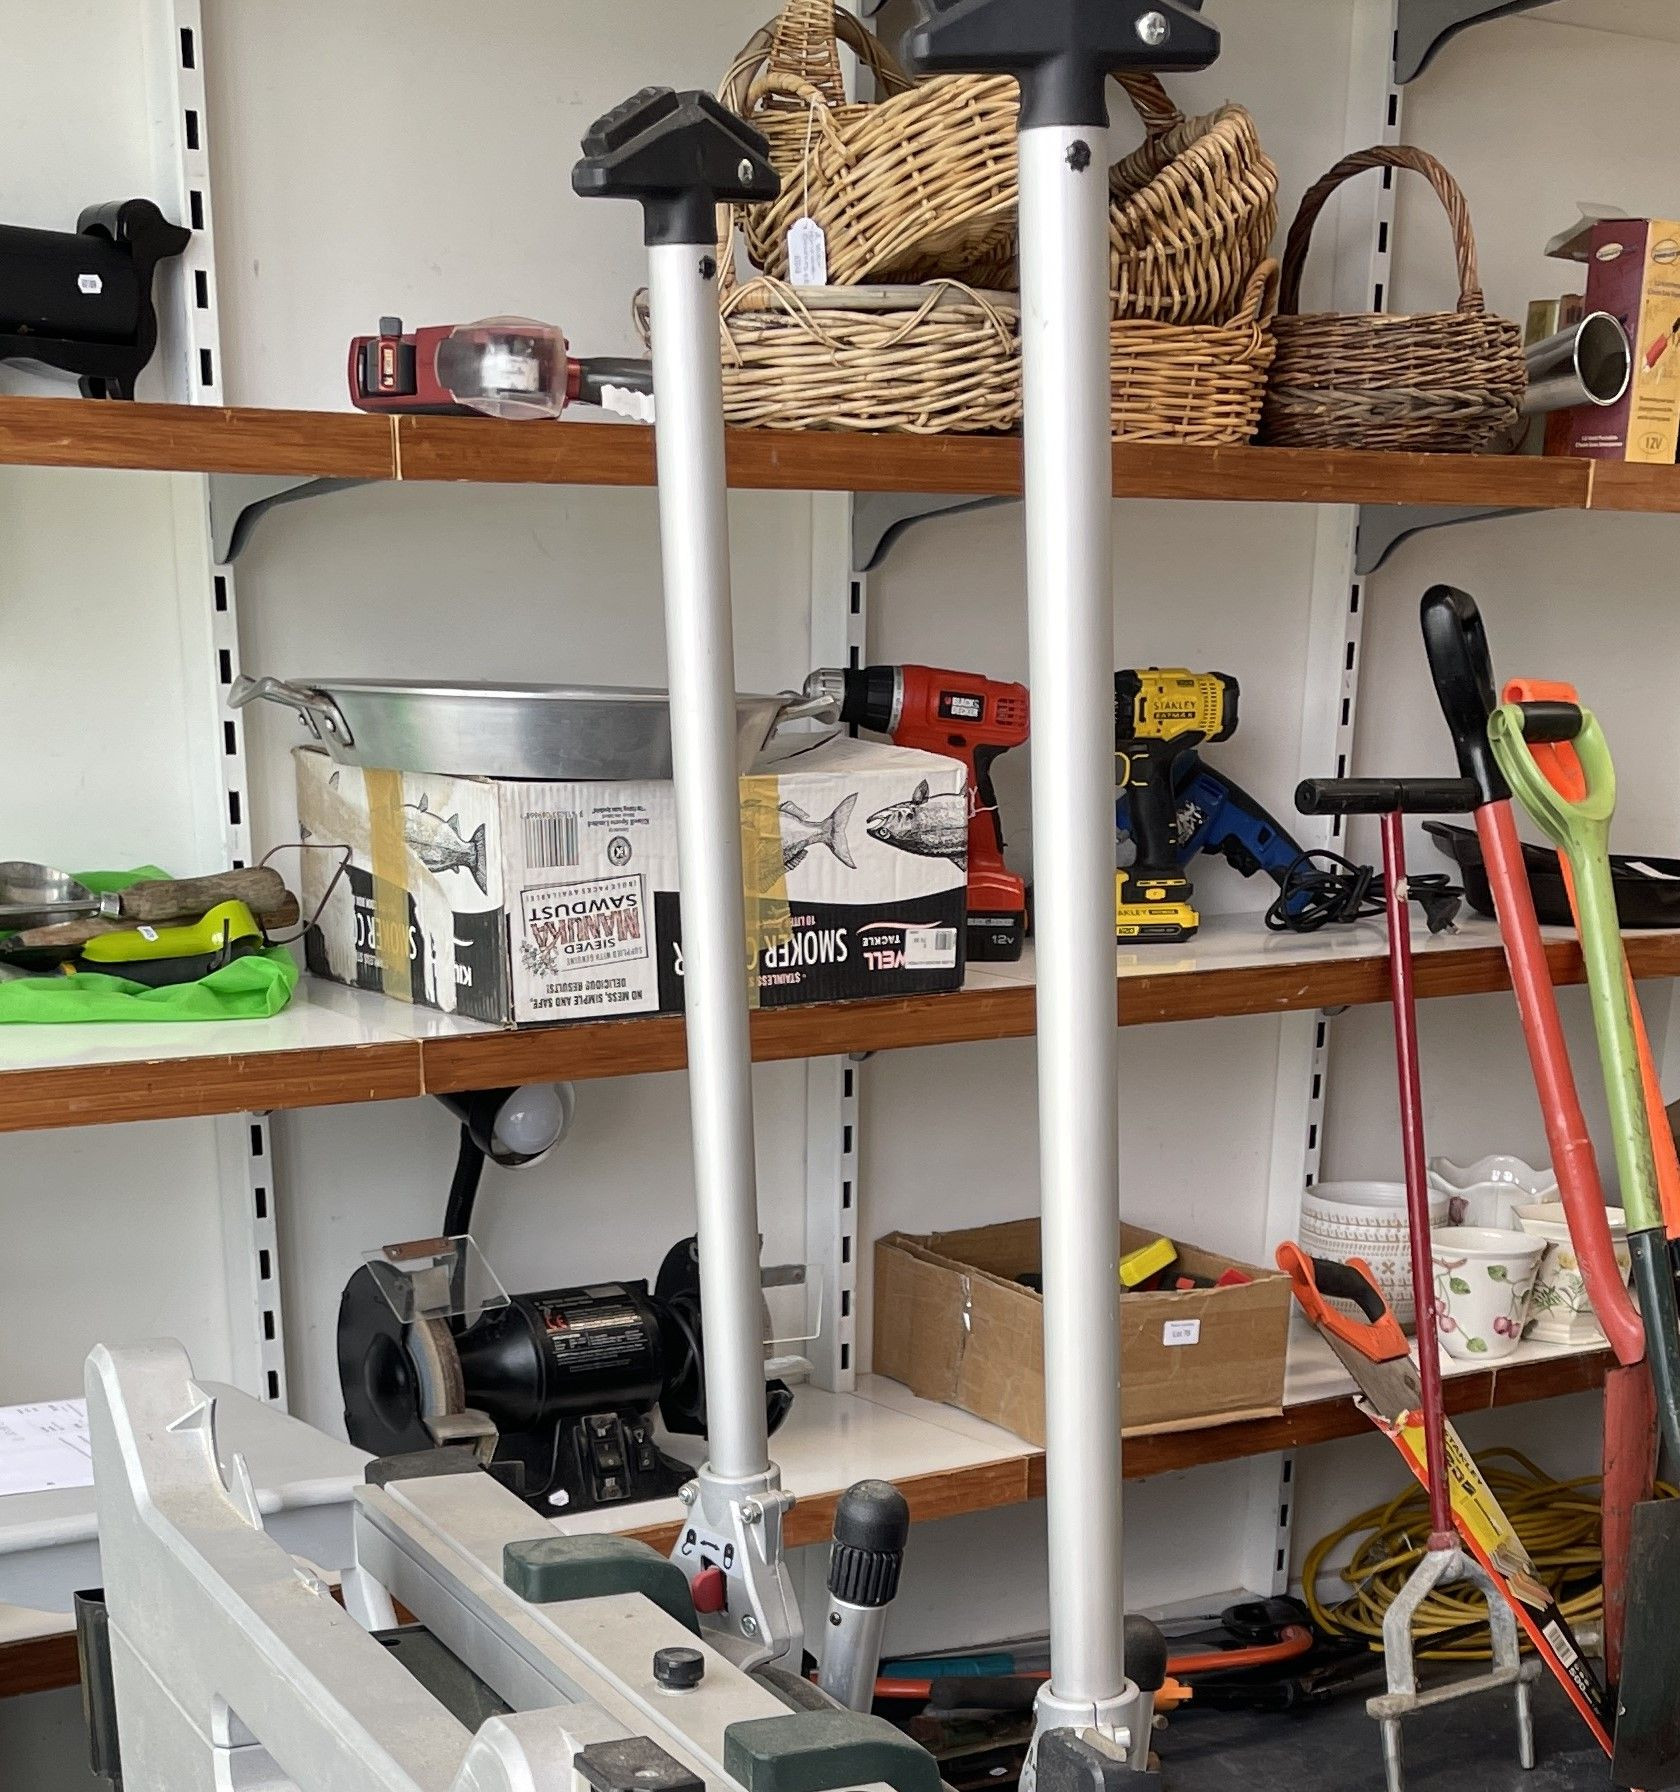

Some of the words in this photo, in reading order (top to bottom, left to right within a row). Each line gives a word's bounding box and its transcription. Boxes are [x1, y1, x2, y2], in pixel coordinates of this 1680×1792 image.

[1153, 701, 1197, 710] STANLEY
[529, 893, 638, 922] SAWDUST
[530, 907, 641, 948] MANUKA
[564, 938, 616, 954] SIEVED
[862, 934, 901, 947] TACKLE
[764, 928, 848, 968] SMOKER
[758, 971, 801, 987] STAINLESS
[574, 994, 603, 1006] SIMPLE
[605, 990, 630, 1003] MESS,
[632, 989, 643, 1000] NO
[529, 998, 553, 1010] SAFE,
[555, 996, 572, 1007] AND
